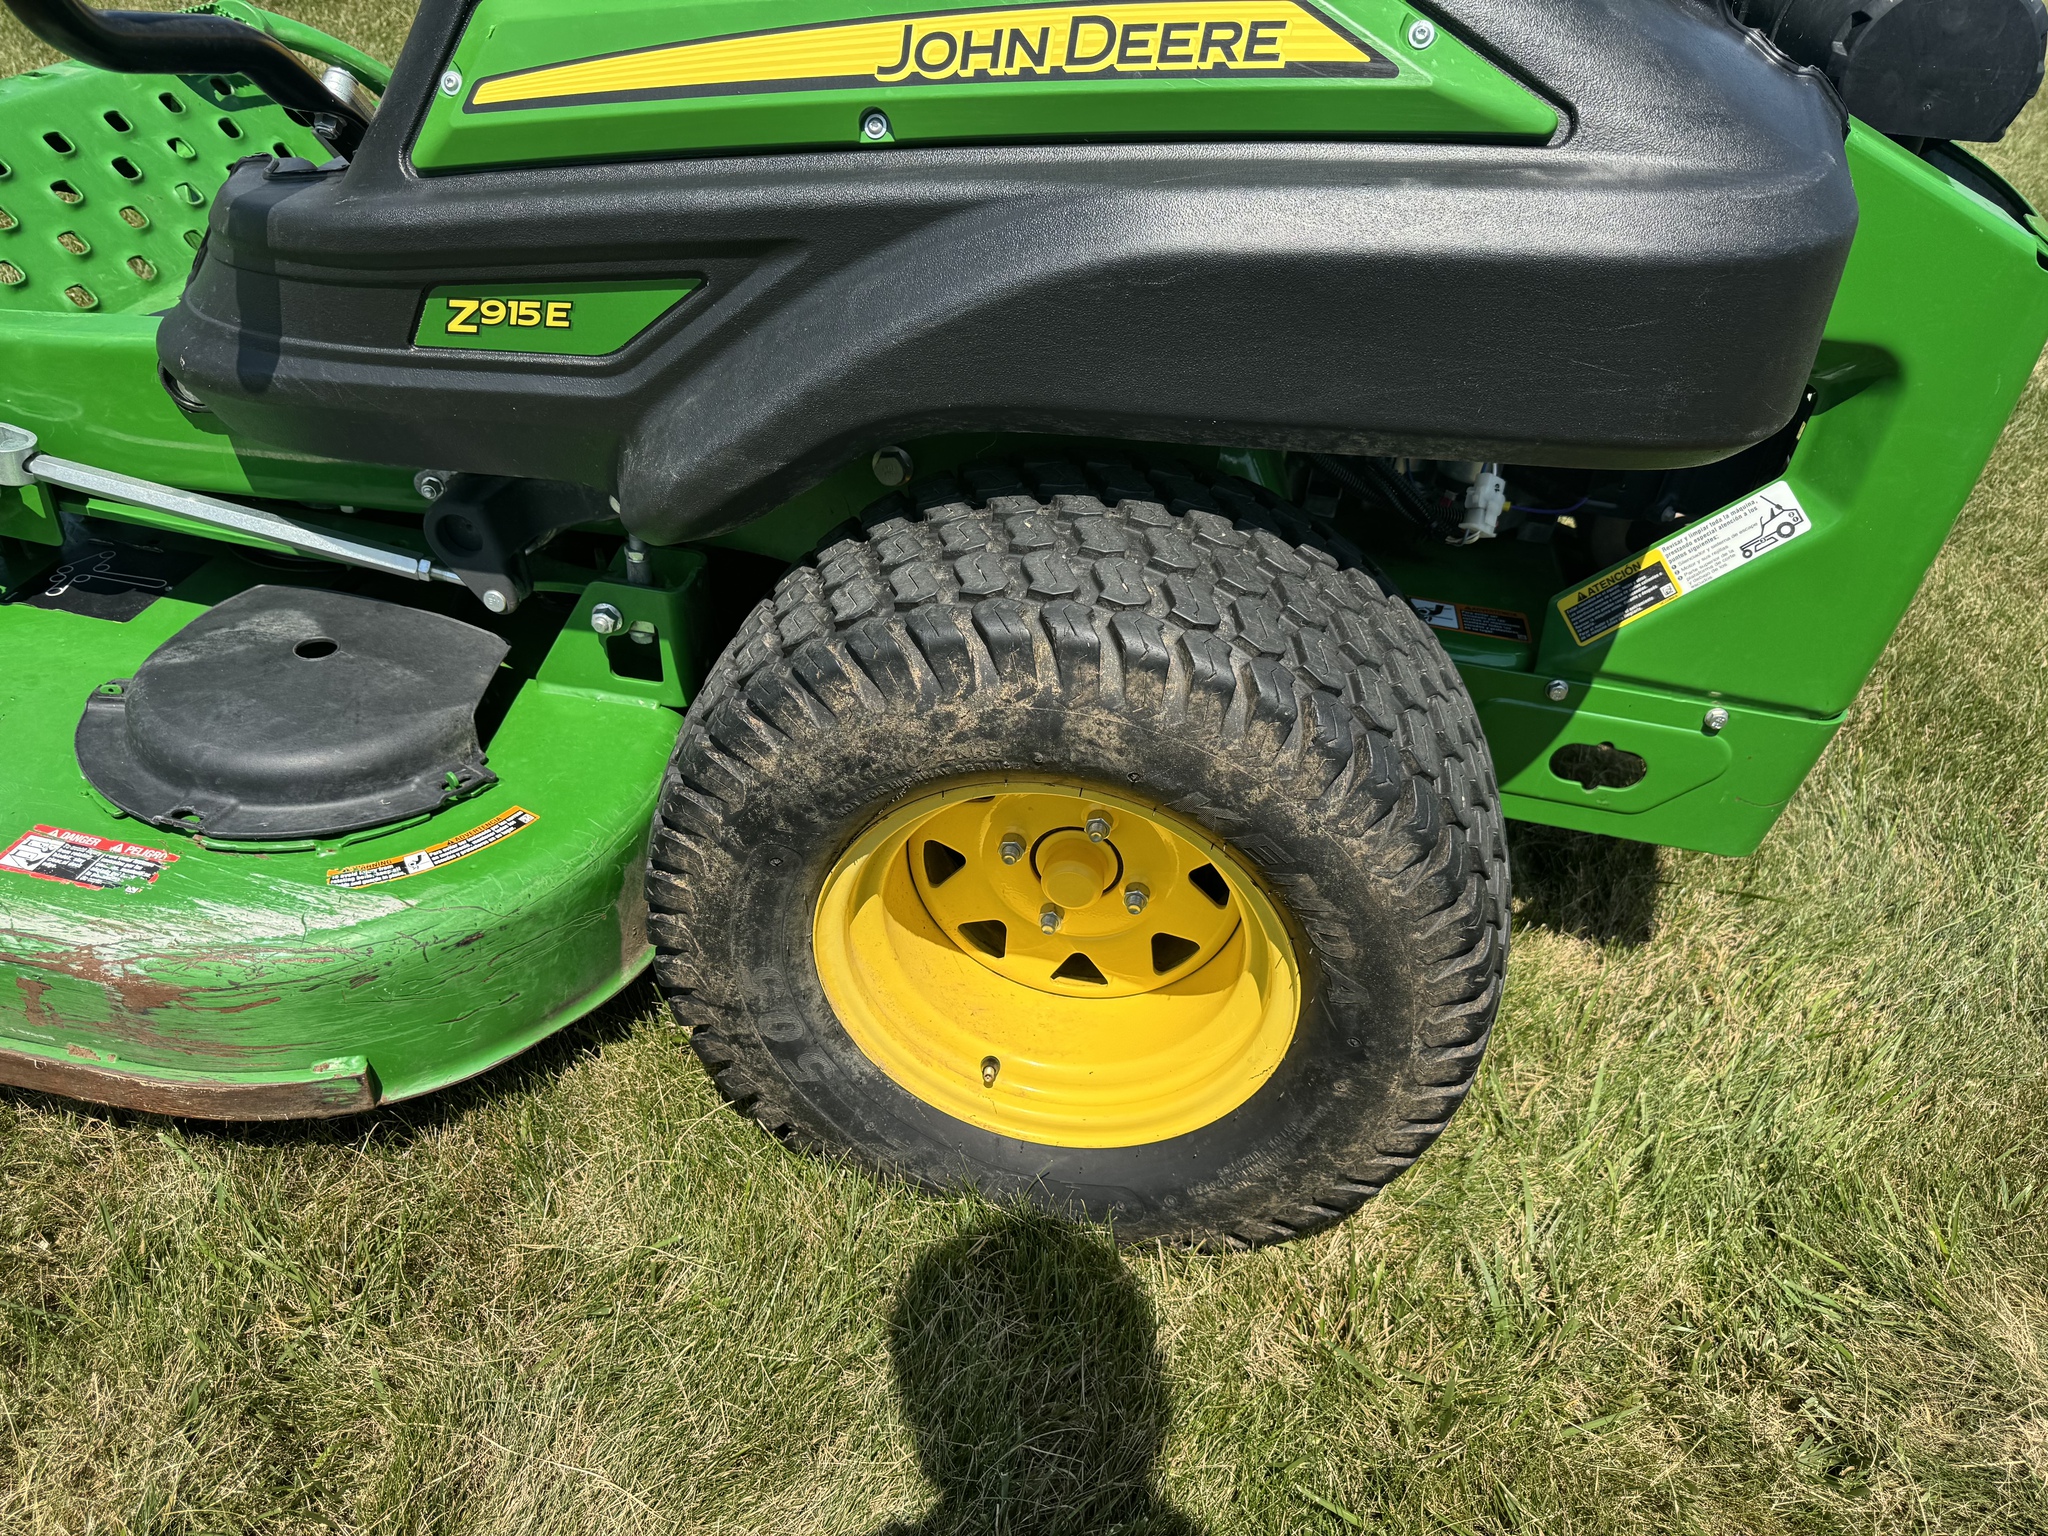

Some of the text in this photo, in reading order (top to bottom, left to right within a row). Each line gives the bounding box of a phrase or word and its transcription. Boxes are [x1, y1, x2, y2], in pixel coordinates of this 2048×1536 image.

[876, 14, 1289, 77] JOHN DEERE
[1661, 538, 1683, 552] Revisar
[1687, 524, 1709, 538] limpiar
[1708, 517, 1723, 527] toda
[1664, 540, 1693, 559] prestando
[1693, 527, 1717, 543] especial
[1747, 505, 1758, 514] los
[1667, 551, 1687, 565] puntos
[1588, 562, 1642, 596] ATENCIÓN
[60, 832, 102, 847] DANGER
[354, 860, 392, 870] ARNING
